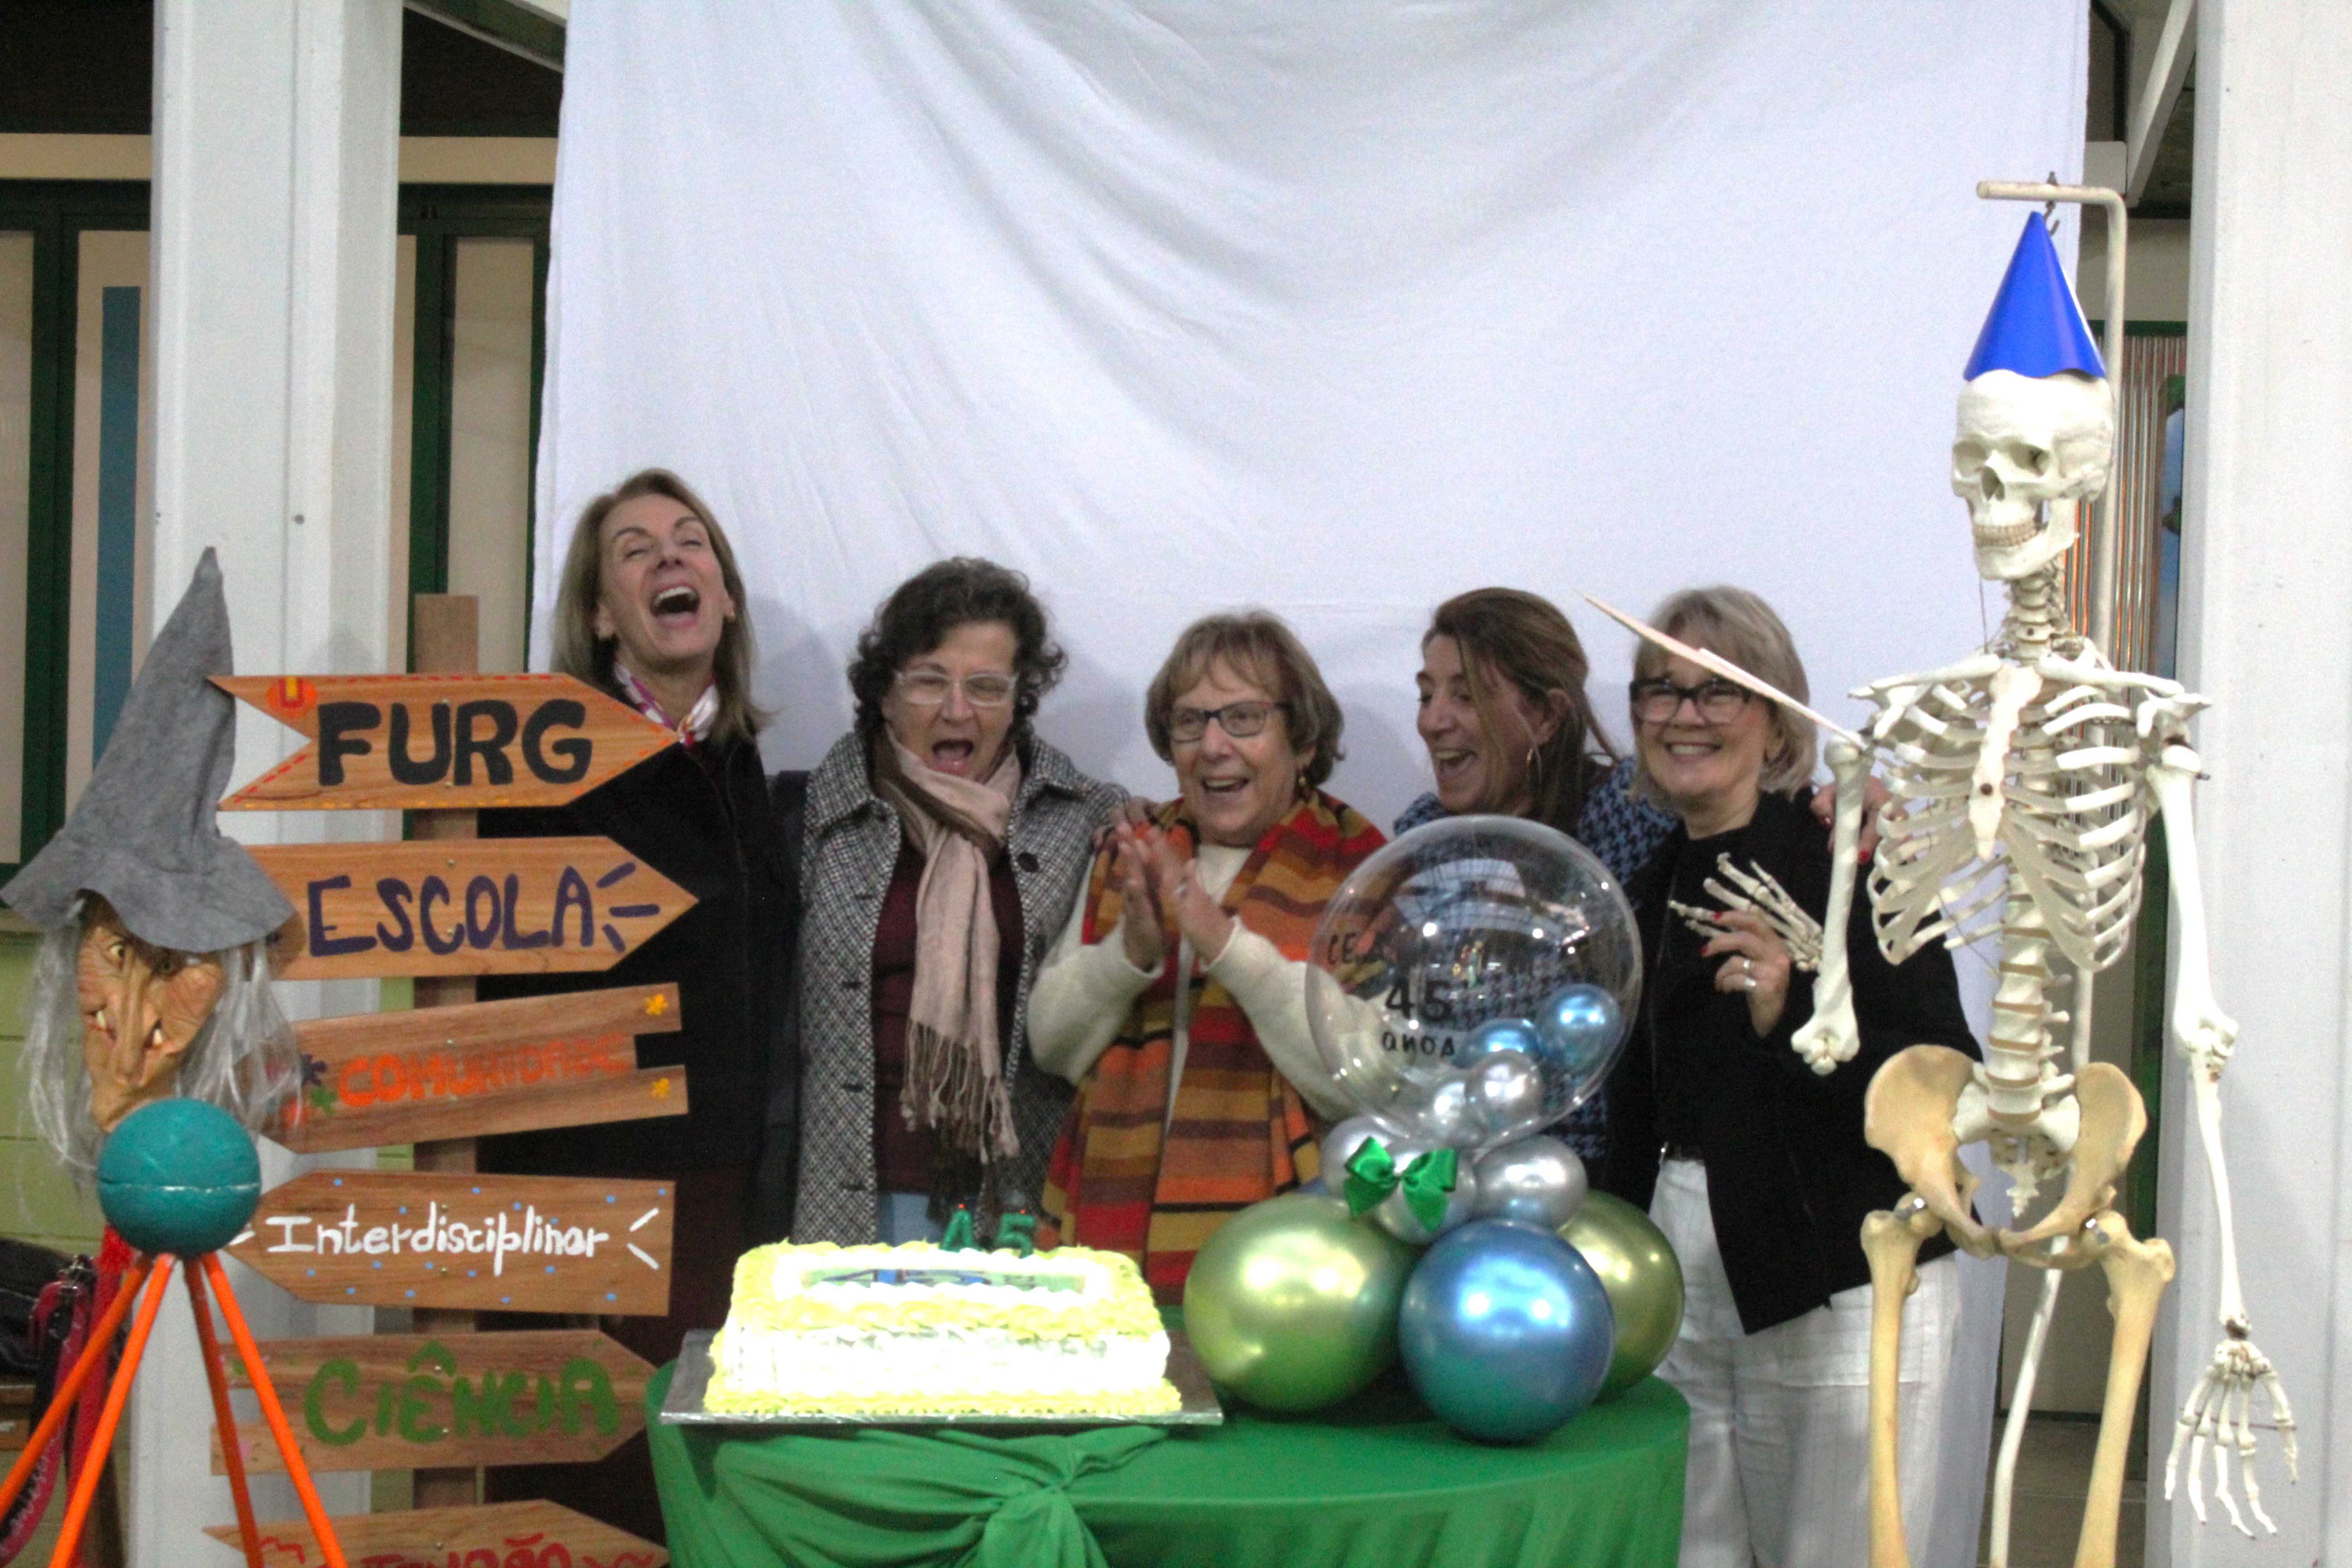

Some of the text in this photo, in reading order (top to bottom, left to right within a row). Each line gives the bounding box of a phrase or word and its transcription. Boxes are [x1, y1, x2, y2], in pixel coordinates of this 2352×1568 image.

[318, 699, 593, 787] FURG
[308, 866, 594, 957] ESCOLA
[265, 1201, 610, 1277] Interdisciplinar
[304, 1340, 621, 1446] CIÊNCIA
